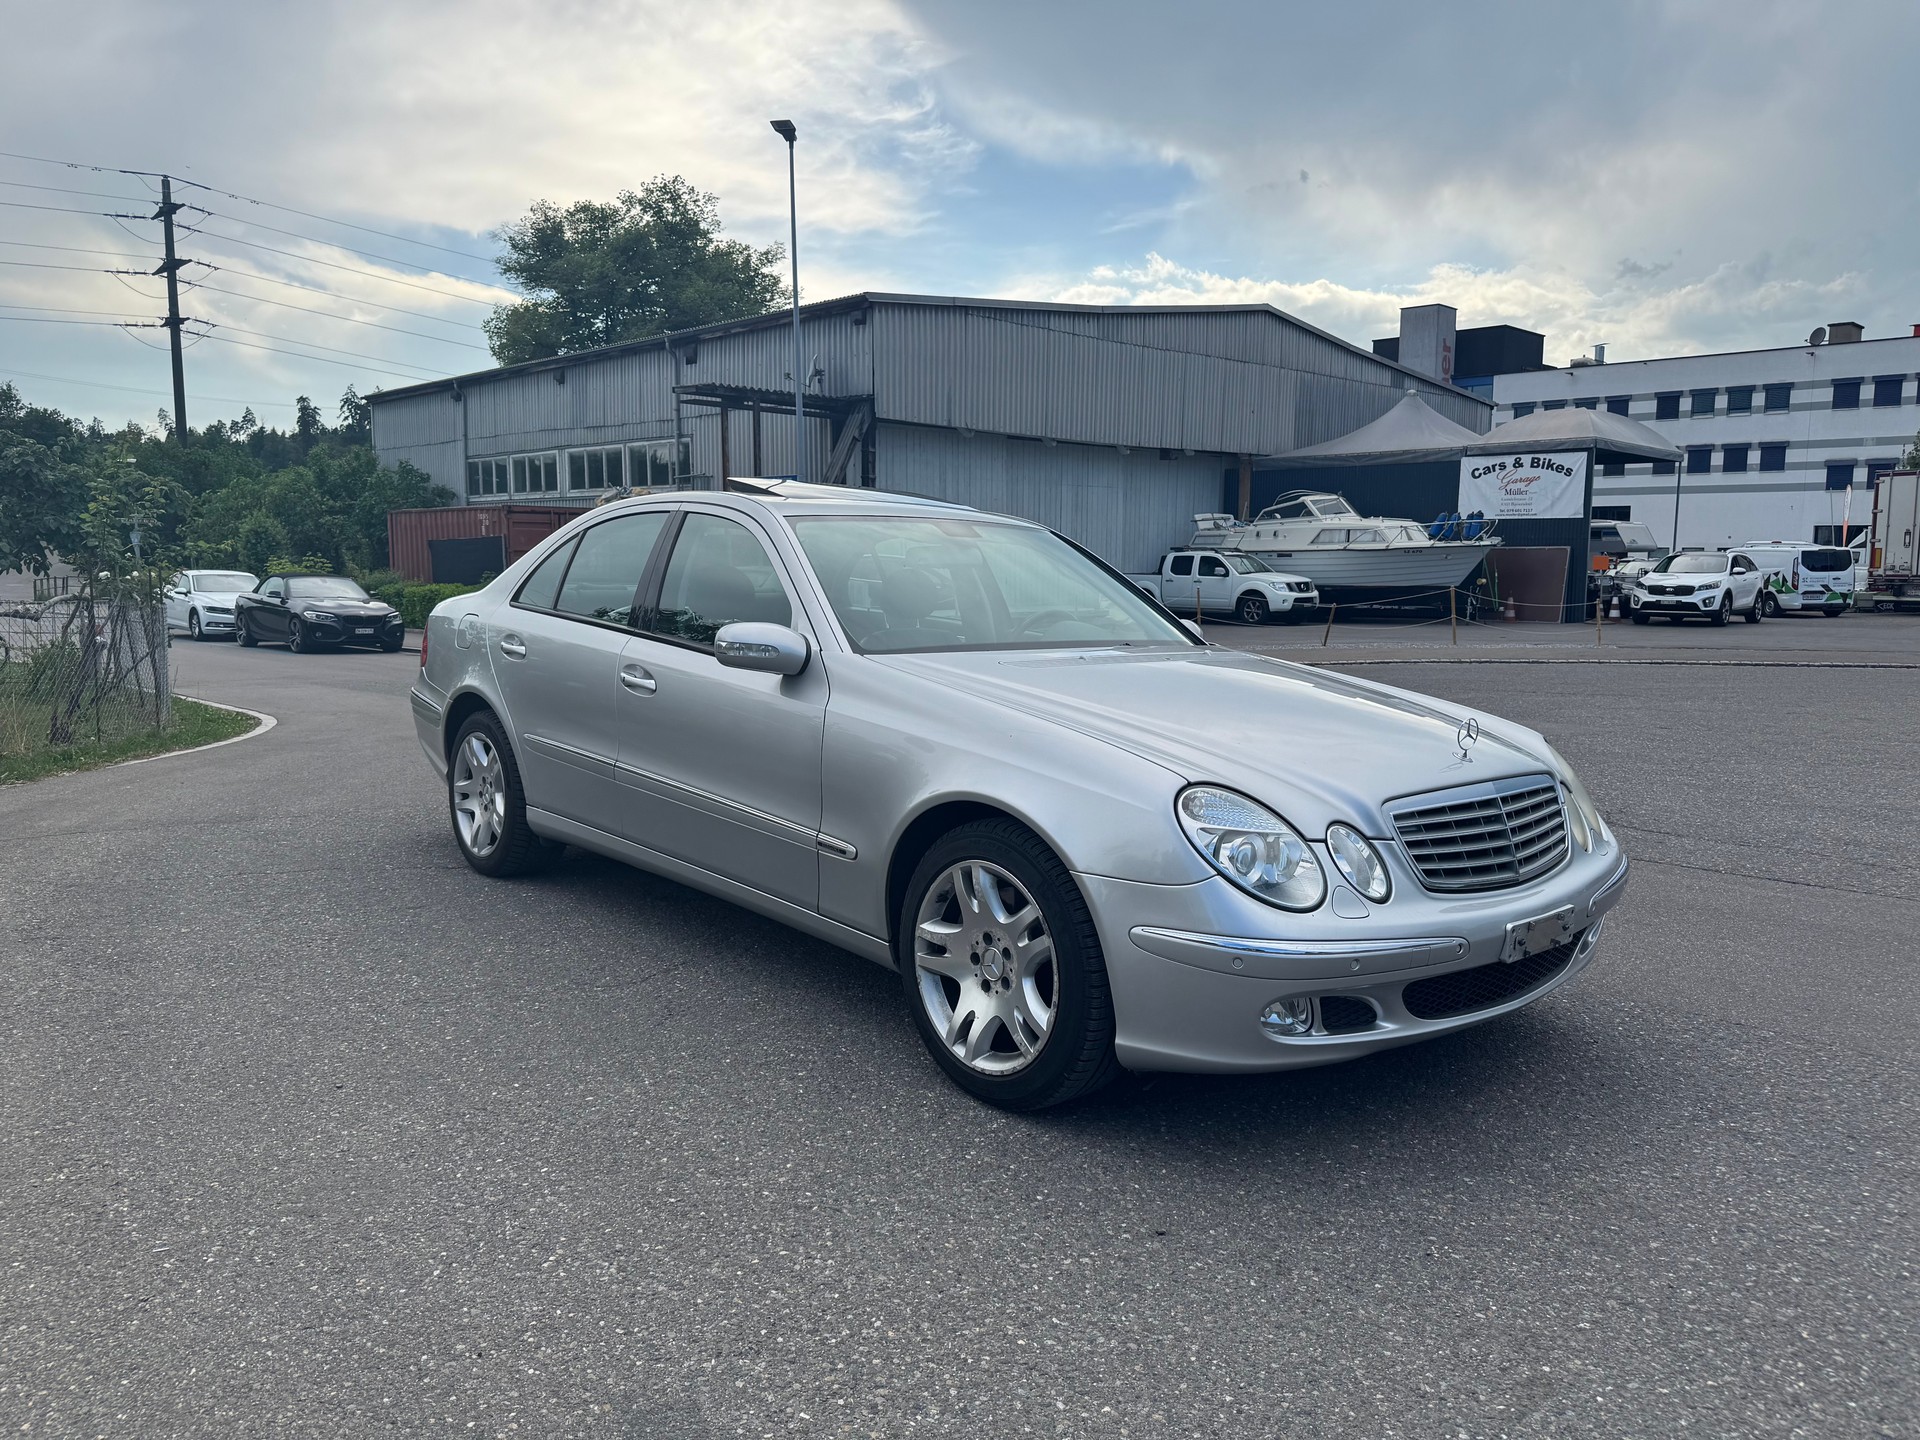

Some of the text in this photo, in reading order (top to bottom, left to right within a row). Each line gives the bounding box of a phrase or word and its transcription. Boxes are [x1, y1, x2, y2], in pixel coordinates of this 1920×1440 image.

[1471, 456, 1574, 480] Cars & Bikes
[1496, 468, 1541, 490] Garage
[1504, 488, 1529, 496] Müller
